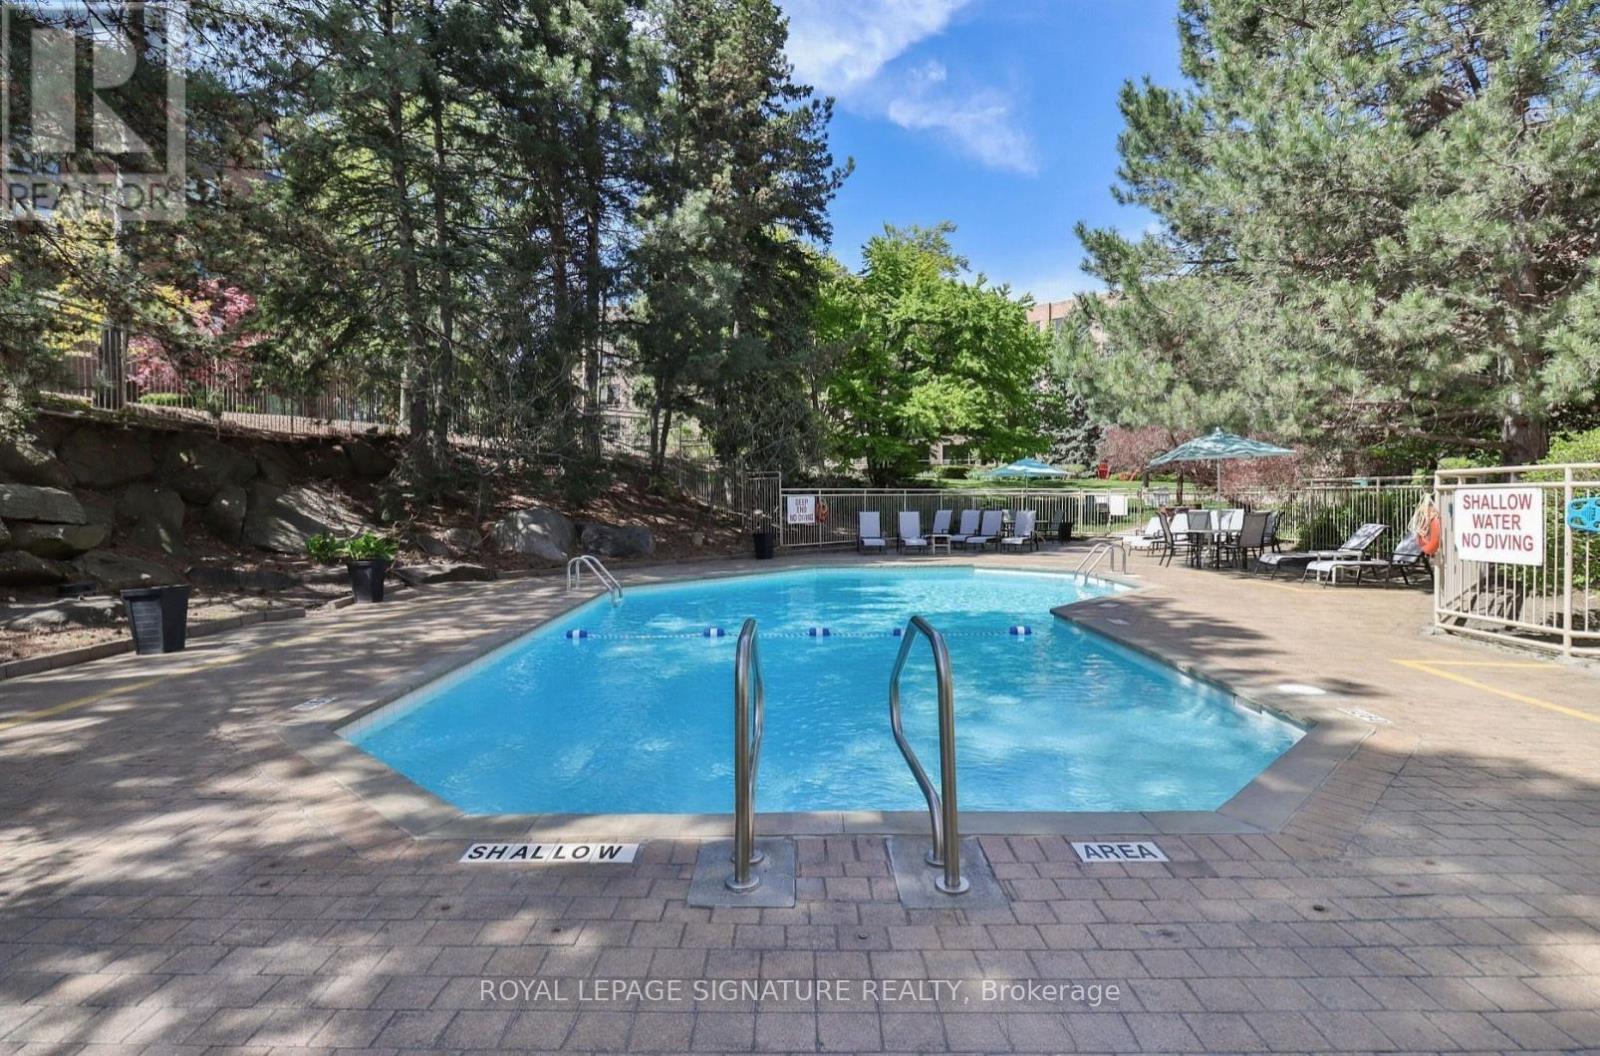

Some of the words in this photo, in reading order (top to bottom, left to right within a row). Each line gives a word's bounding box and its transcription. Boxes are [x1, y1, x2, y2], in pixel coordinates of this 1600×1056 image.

[1463, 493, 1532, 511] SHALLOW
[1472, 514, 1521, 530] WATER
[1462, 533, 1481, 548] NO
[1485, 533, 1534, 551] DIVING
[468, 845, 622, 860] SHALLOW
[1083, 844, 1158, 859] AREA
